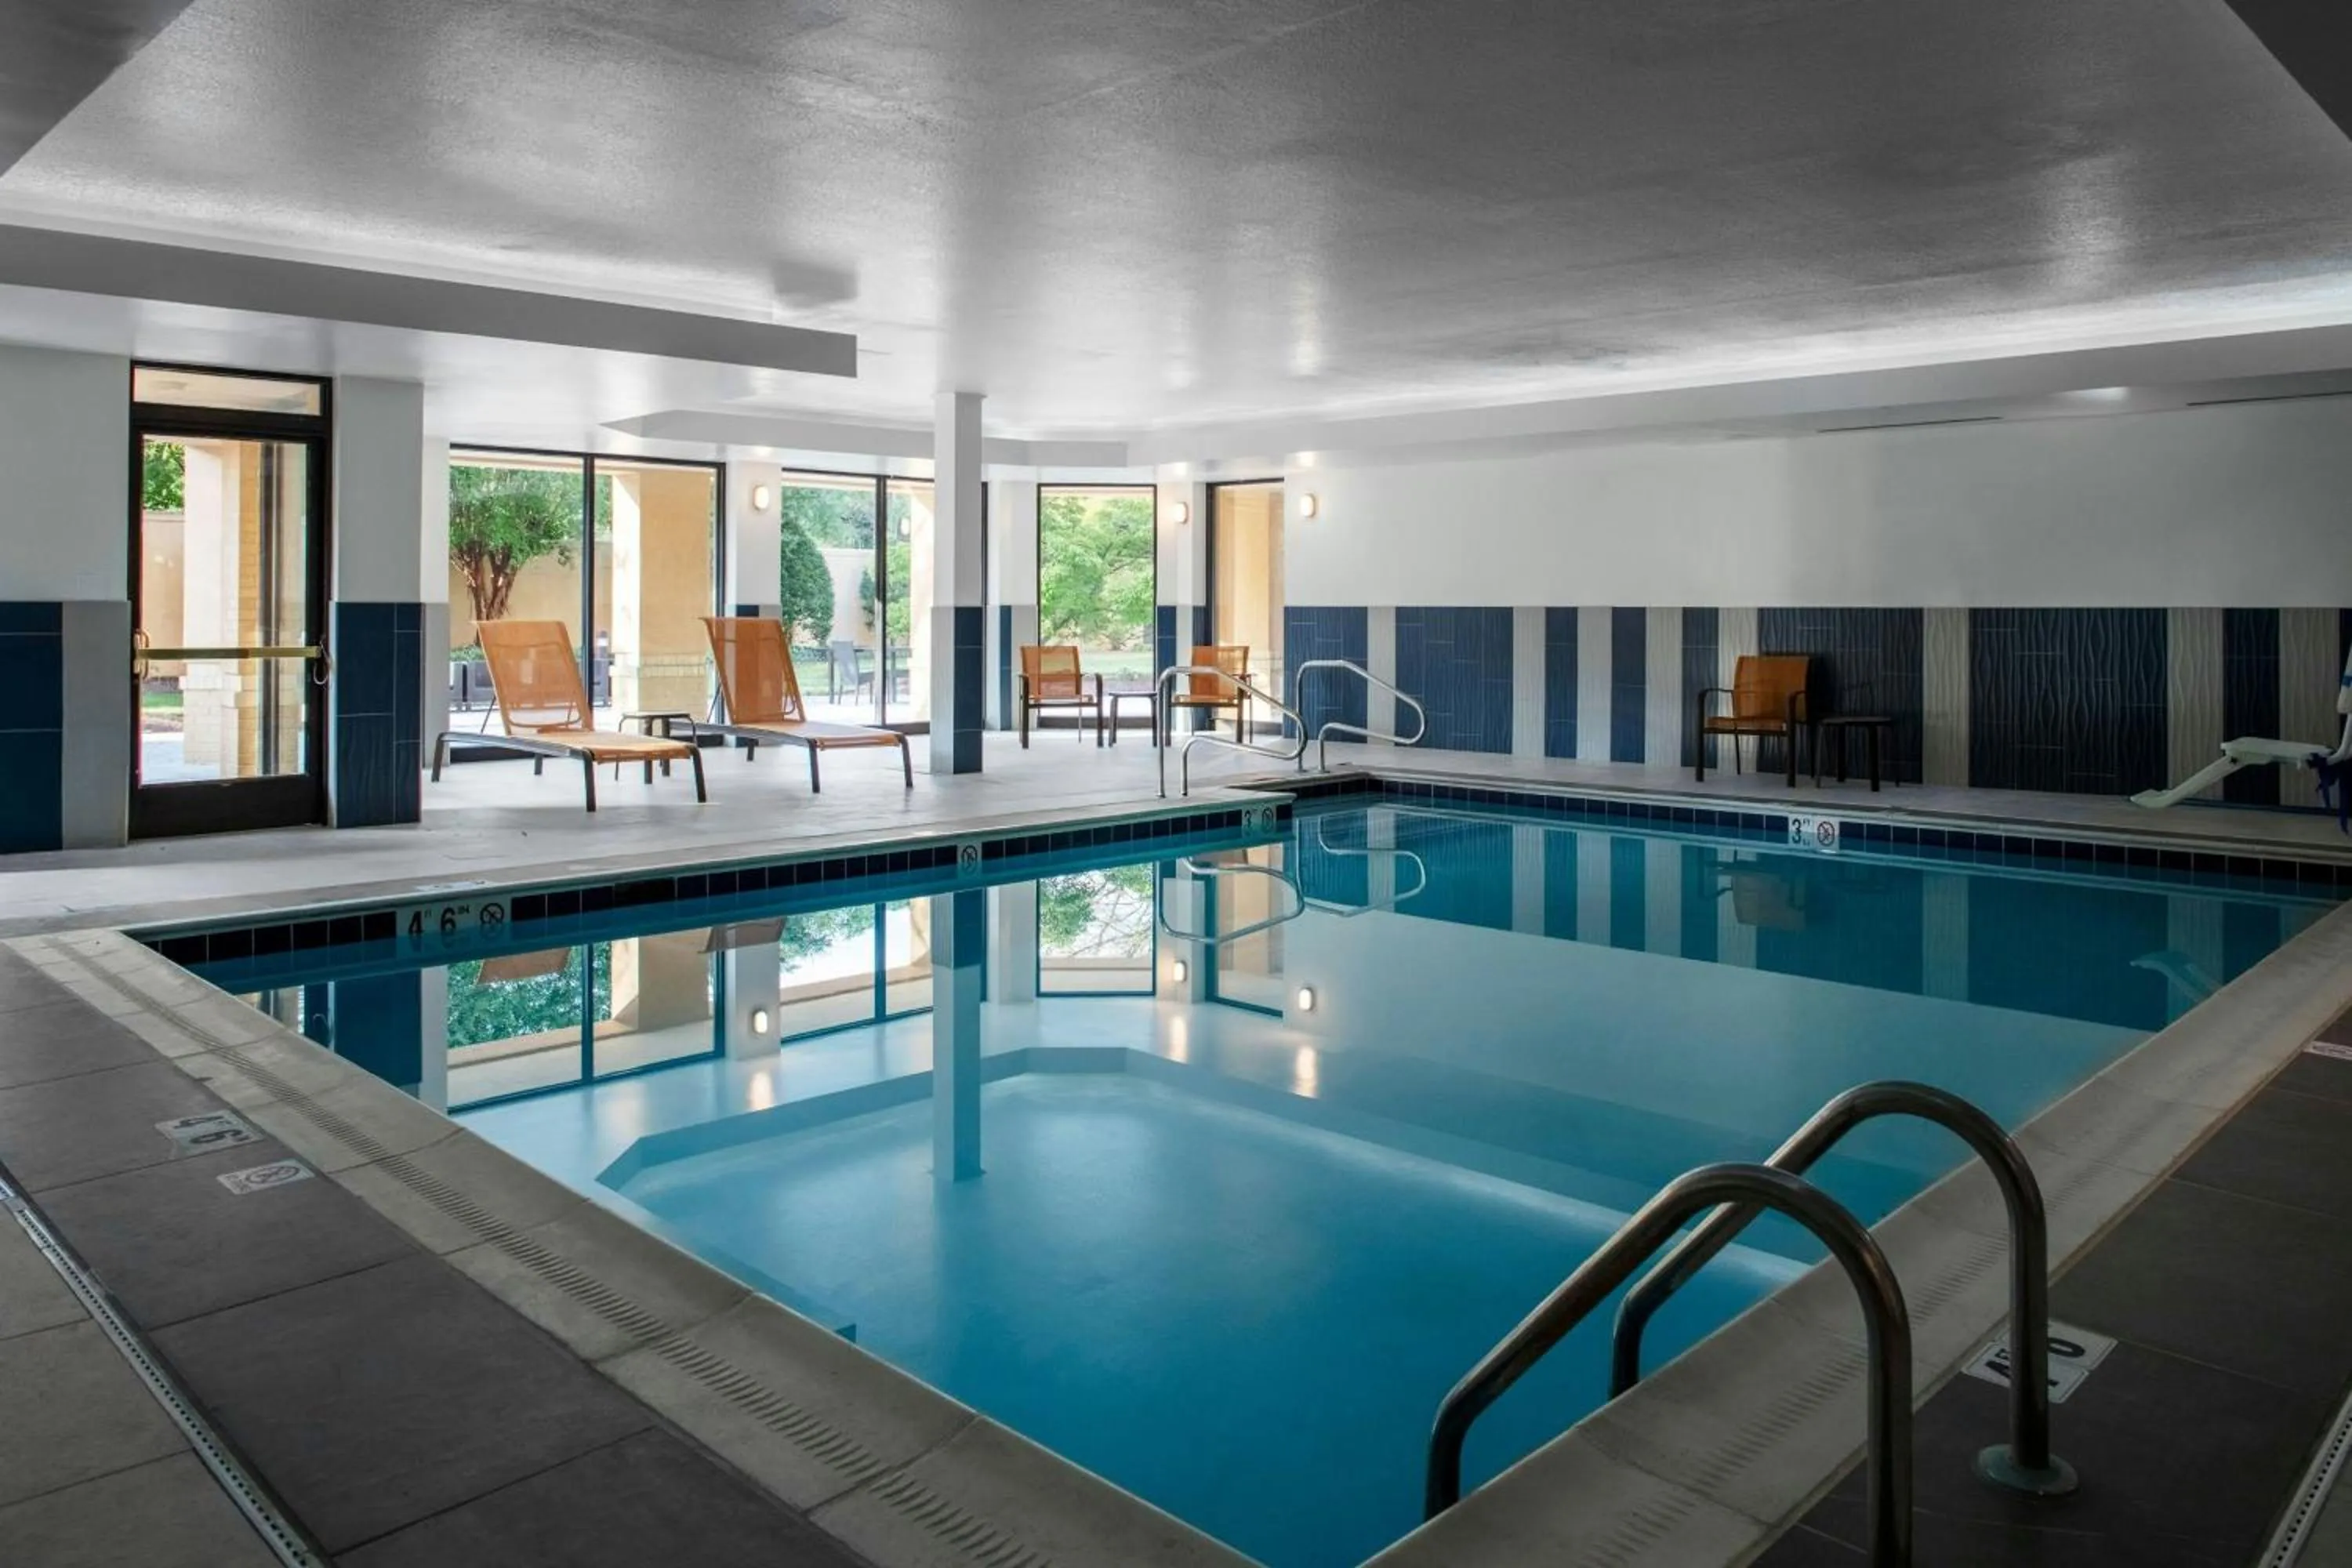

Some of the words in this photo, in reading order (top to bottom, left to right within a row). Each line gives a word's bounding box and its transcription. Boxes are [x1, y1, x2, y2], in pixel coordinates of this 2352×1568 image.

[1791, 818, 1802, 843] 3
[408, 910, 425, 934] 4
[441, 906, 456, 932] 6
